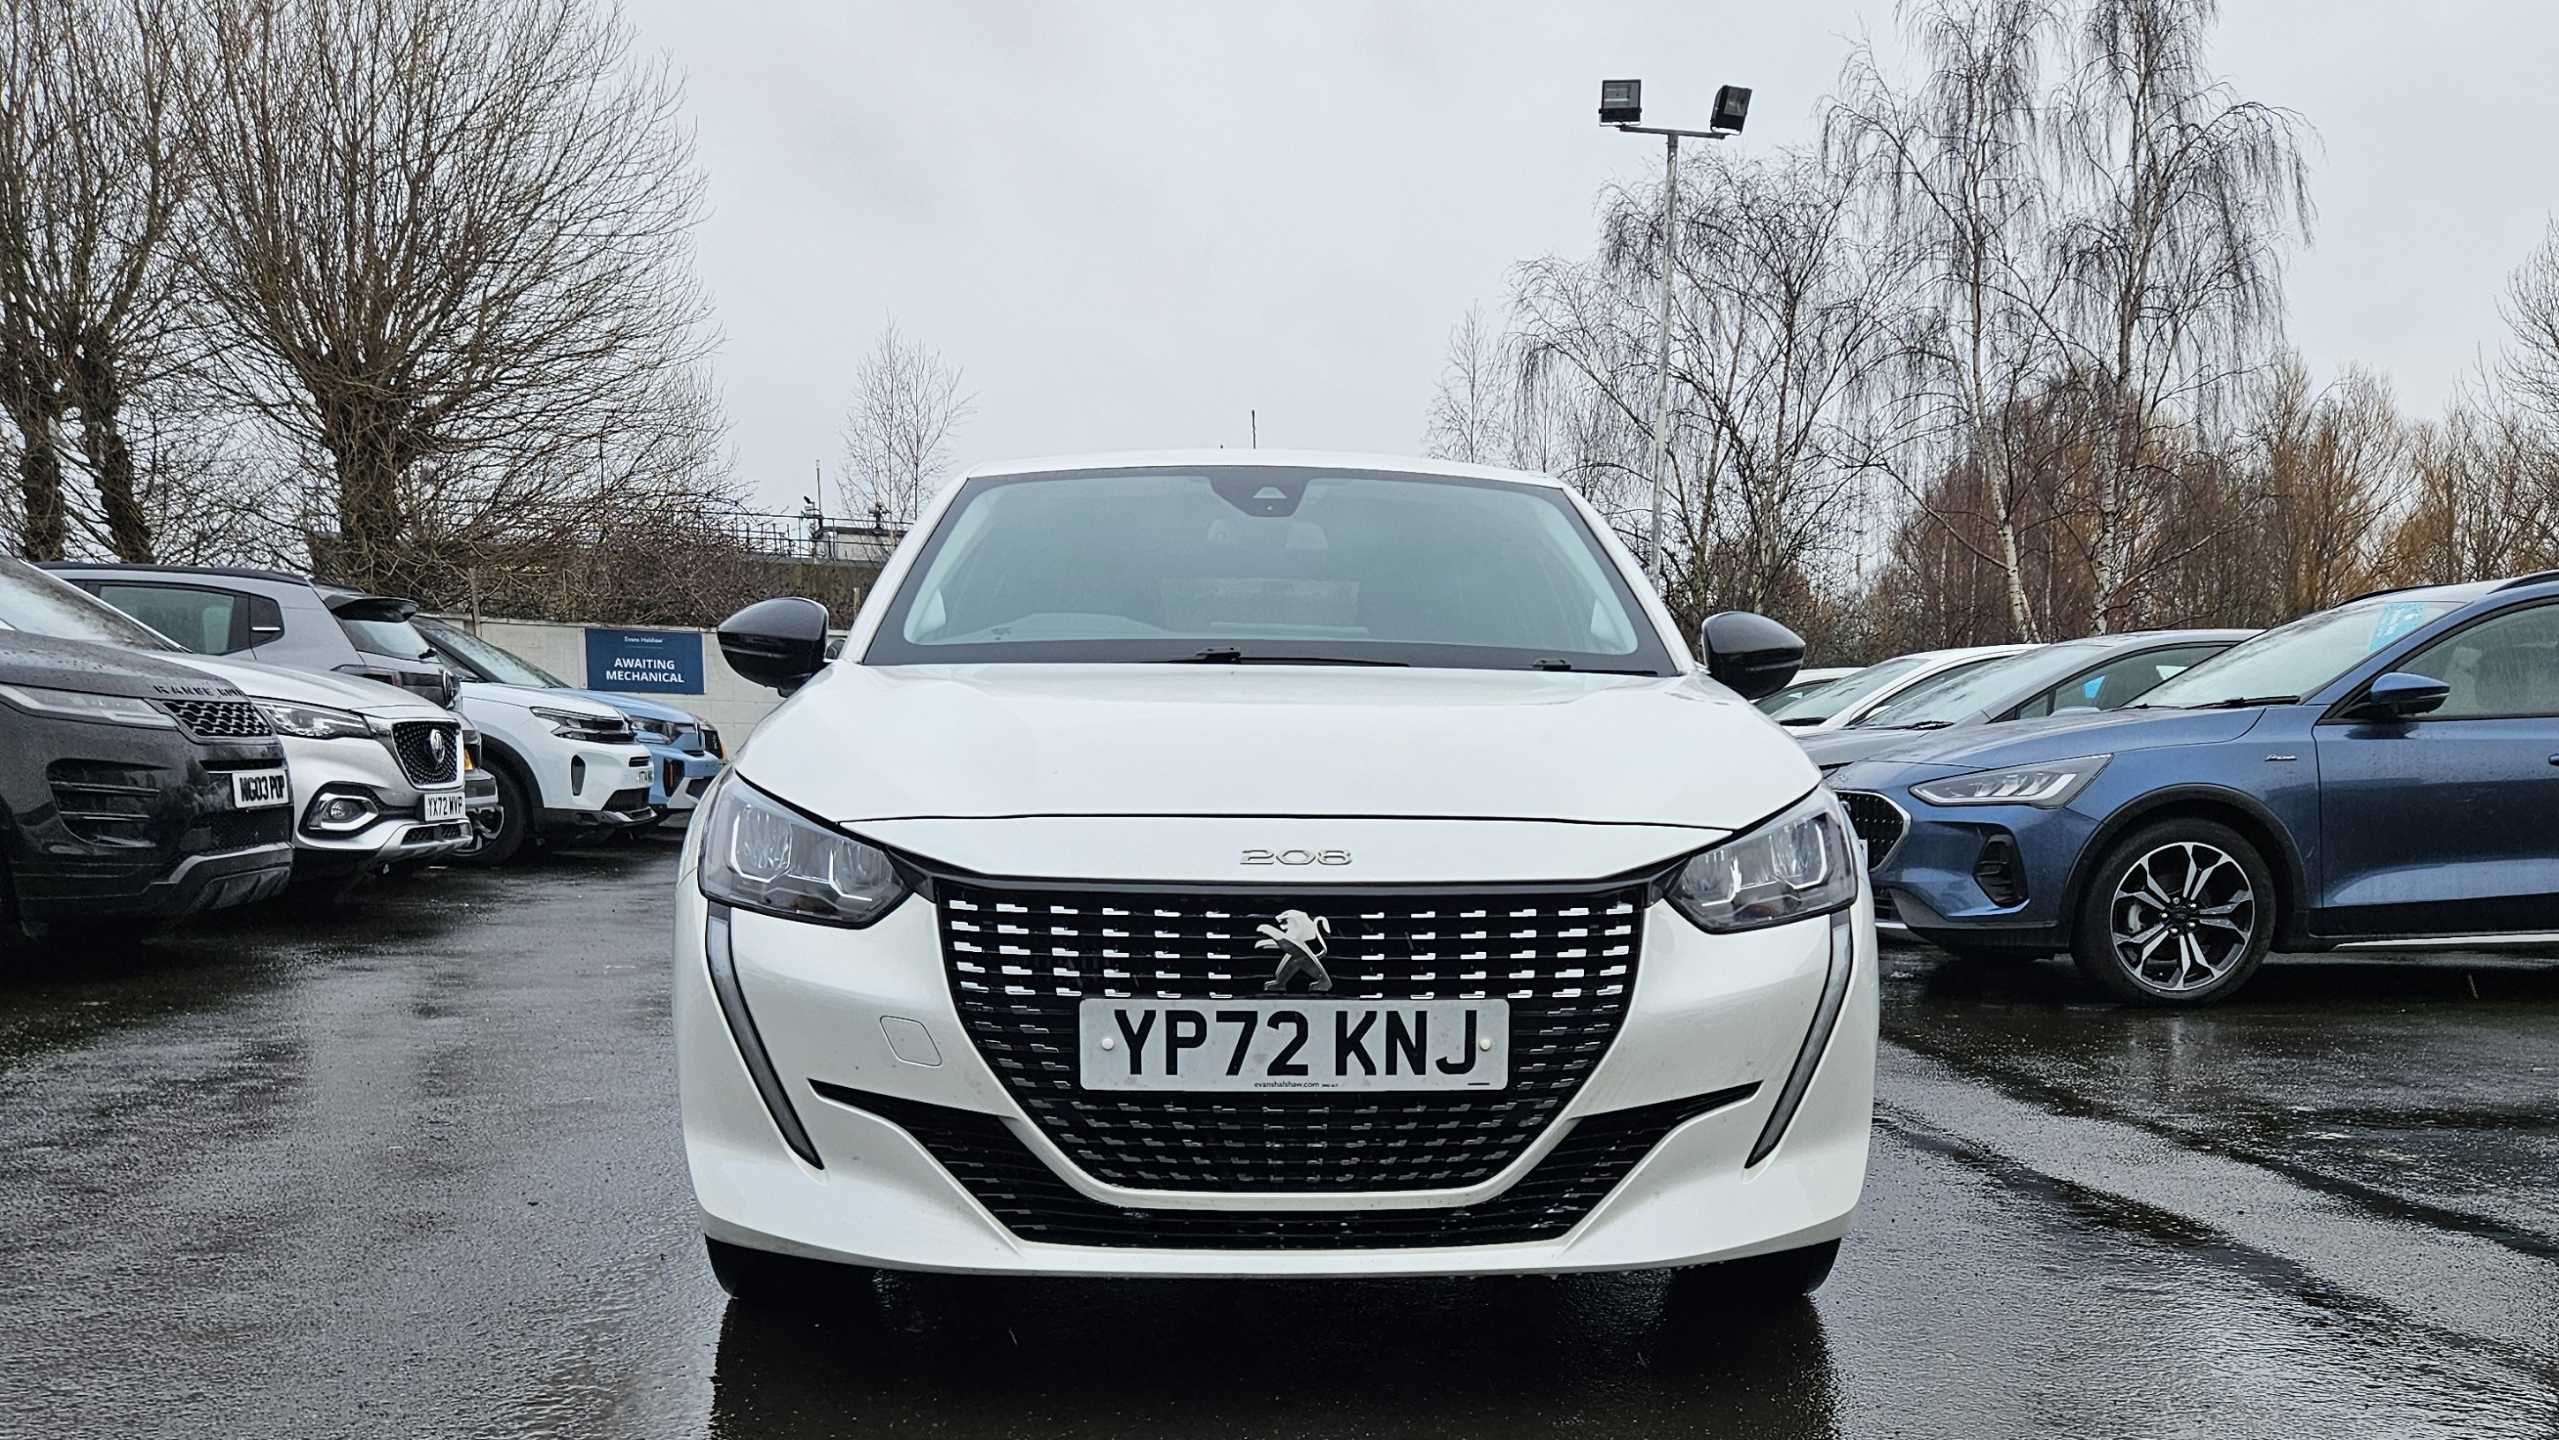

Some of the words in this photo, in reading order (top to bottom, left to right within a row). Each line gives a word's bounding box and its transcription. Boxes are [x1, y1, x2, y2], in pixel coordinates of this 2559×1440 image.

[614, 657, 676, 671] AWAITING
[606, 670, 685, 683] MECHANICAL
[1239, 849, 1353, 866] 208
[1113, 1009, 1310, 1077] YP72
[1334, 1009, 1478, 1077] KNJ
